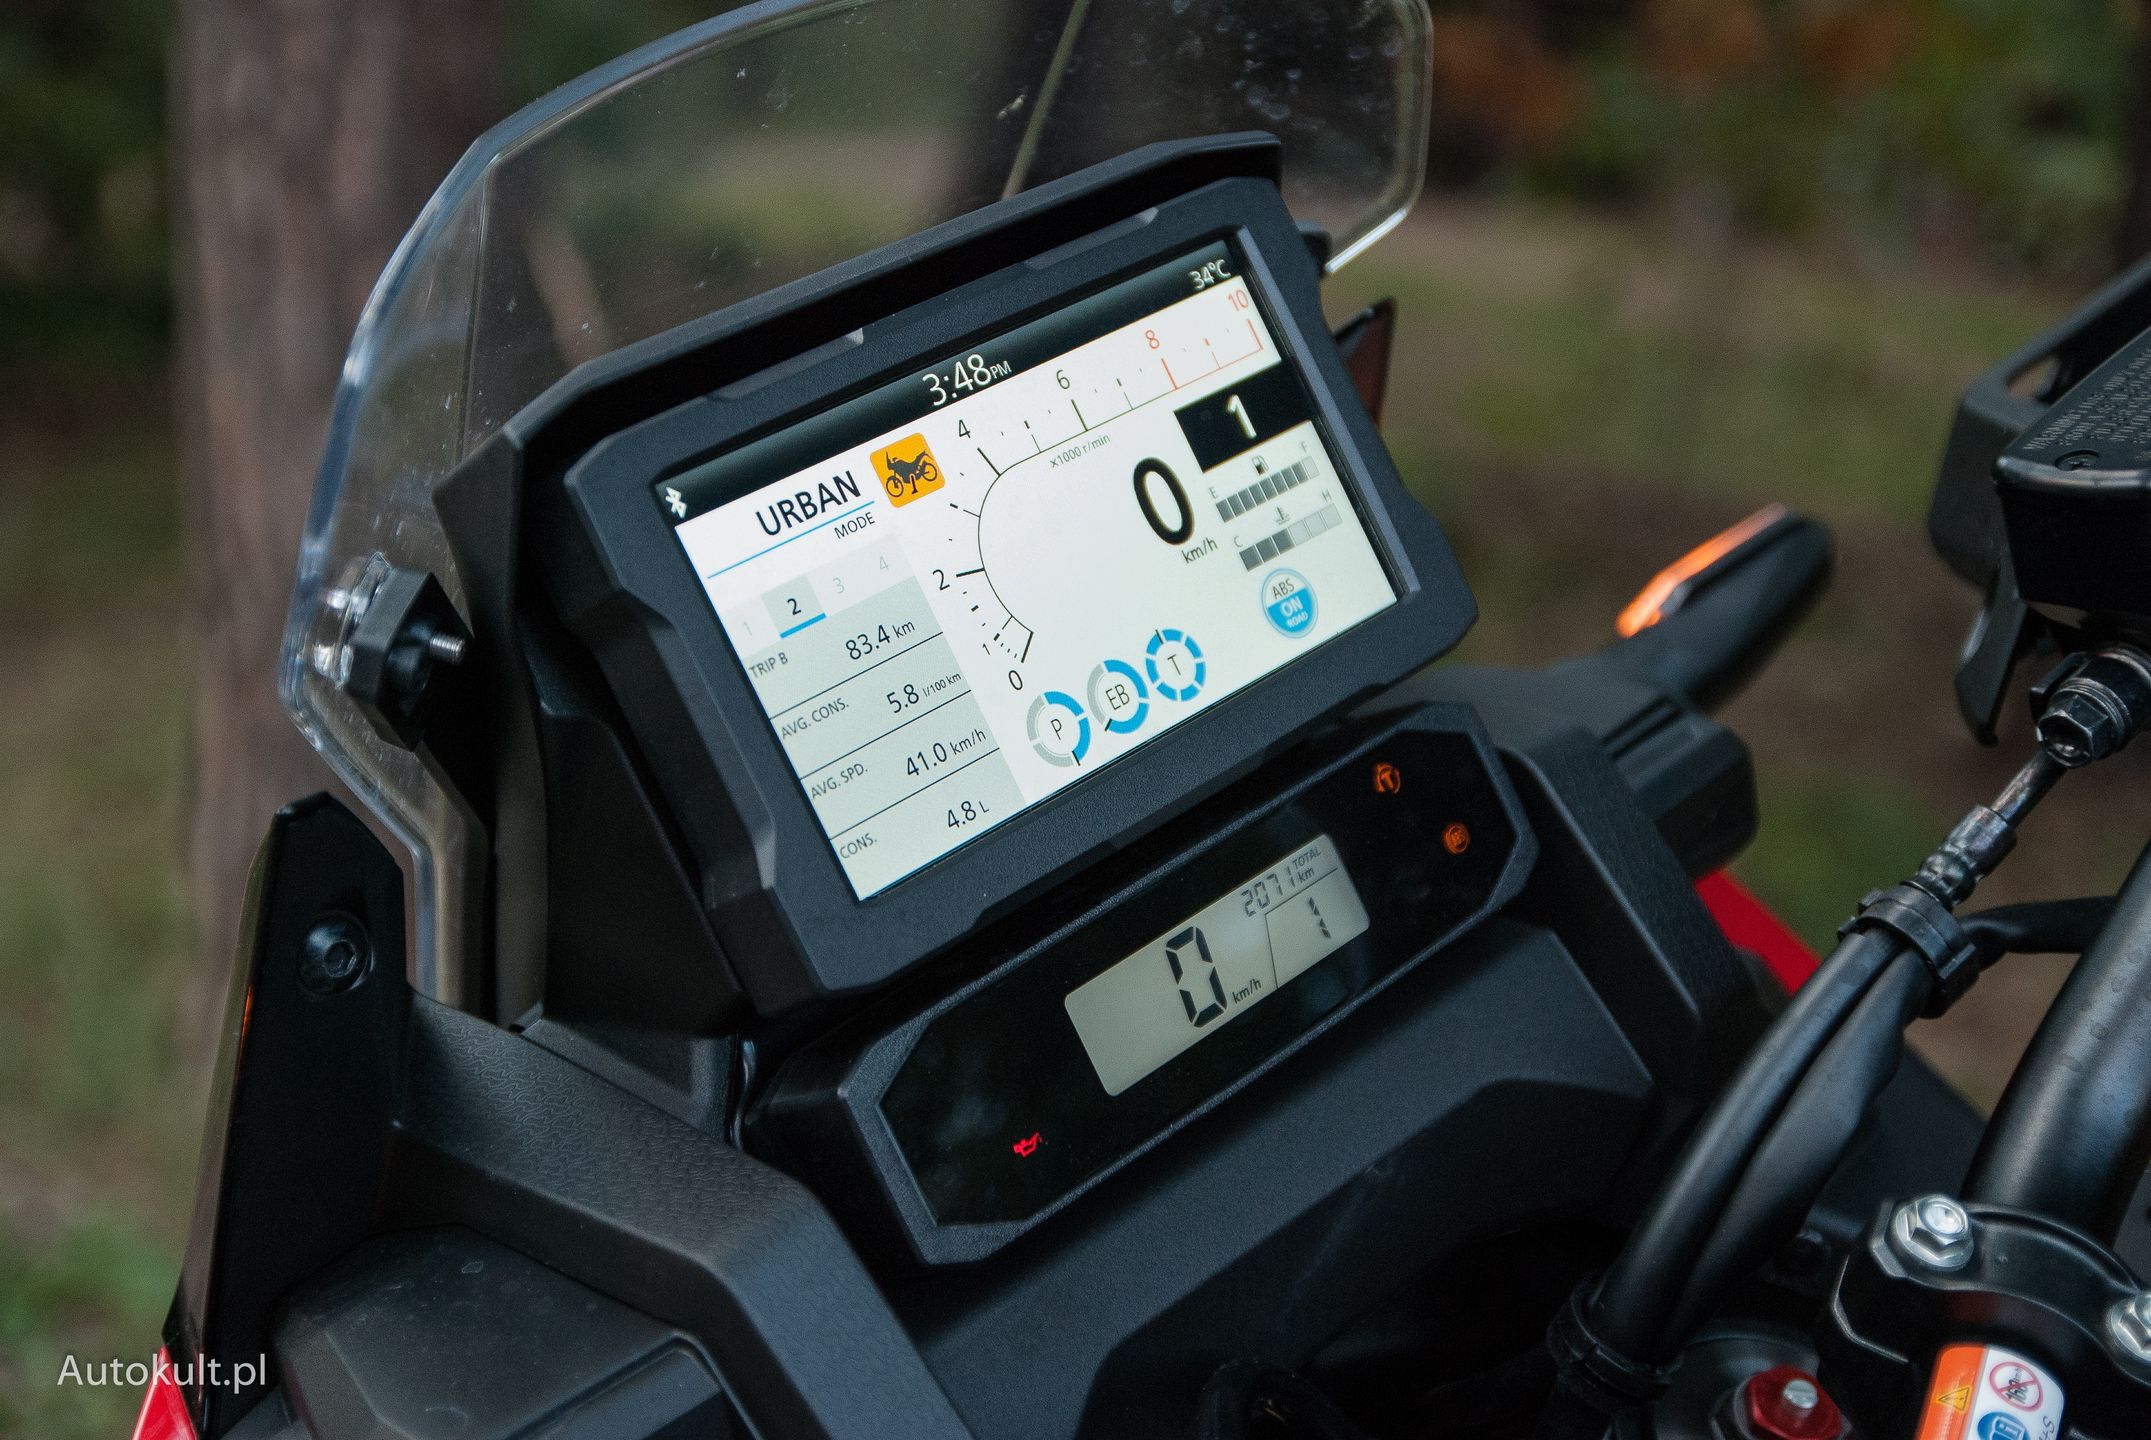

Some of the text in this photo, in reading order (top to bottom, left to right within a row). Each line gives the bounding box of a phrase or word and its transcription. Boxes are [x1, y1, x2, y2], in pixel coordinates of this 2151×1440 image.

[1227, 289, 1250, 312] 10
[1145, 329, 1160, 350] 8
[1055, 369, 1071, 391] 6
[958, 420, 971, 439] 4
[1226, 394, 1257, 439] 1
[1081, 433, 1111, 456] r/min
[1300, 441, 1309, 453] F
[756, 470, 861, 537] URBAN
[1133, 456, 1195, 546] 0
[1209, 486, 1219, 500] E
[1322, 488, 1333, 502] H
[834, 511, 876, 540] MODE
[1181, 536, 1218, 564] km/h
[1233, 535, 1243, 548] C
[787, 598, 802, 616] 2
[833, 577, 845, 594] 3
[879, 556, 889, 571] 4
[932, 569, 950, 591] 2
[1272, 578, 1295, 600] ABS
[1281, 595, 1303, 617] ON
[846, 620, 915, 661] 83.4 km
[982, 643, 990, 655] 1
[750, 652, 789, 679] TRIP B
[1167, 654, 1181, 675] T
[886, 684, 920, 714] 5.8
[947, 671, 962, 688] km
[1008, 670, 1023, 691] 0
[1105, 684, 1130, 711] EB
[781, 697, 850, 739] AVG. CONS.
[1051, 718, 1062, 740] P
[906, 728, 987, 778] 41.0 km/h
[811, 762, 869, 800] AVG. SPD.
[947, 800, 990, 830] 4.8 L
[839, 832, 878, 859] CONS.
[1292, 847, 1321, 870] TOTAL
[1240, 865, 1315, 917] 2071 km
[1309, 897, 1331, 939] 1
[1165, 926, 1262, 1028] 0 km/h
